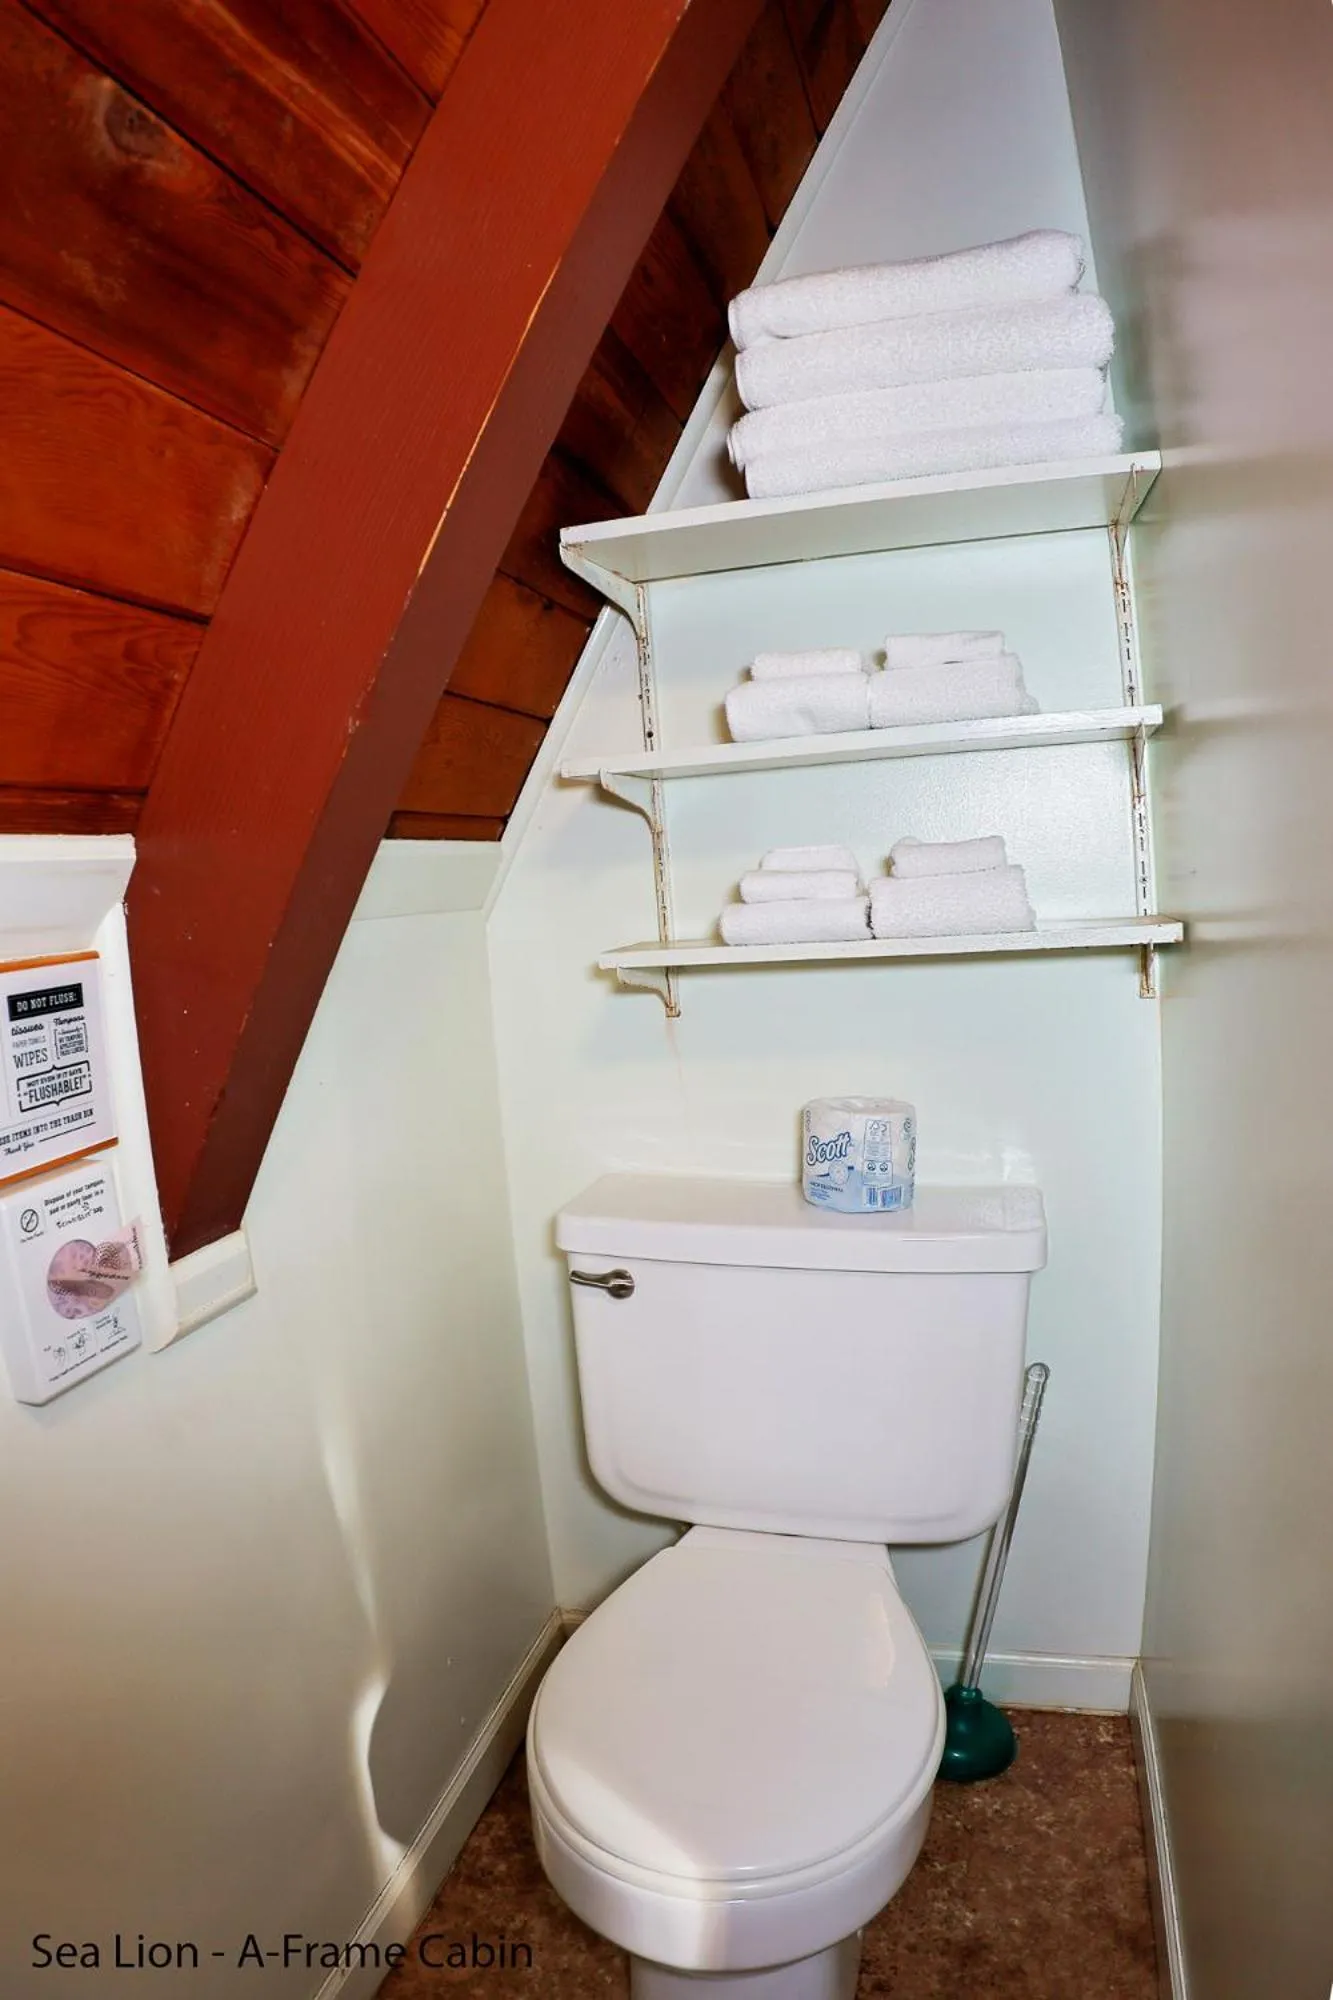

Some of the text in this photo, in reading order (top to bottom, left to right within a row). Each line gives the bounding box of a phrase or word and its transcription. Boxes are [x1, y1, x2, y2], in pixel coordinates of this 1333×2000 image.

[16, 1000, 28, 1012] DO
[30, 997, 47, 1009] NOT
[13, 1047, 48, 1069] WIPES
[12, 1128, 32, 1142] ITEMS
[33, 1122, 48, 1134] INTO
[49, 1118, 62, 1129] THE
[63, 1112, 82, 1124] TRASH
[806, 1131, 851, 1166] Scott
